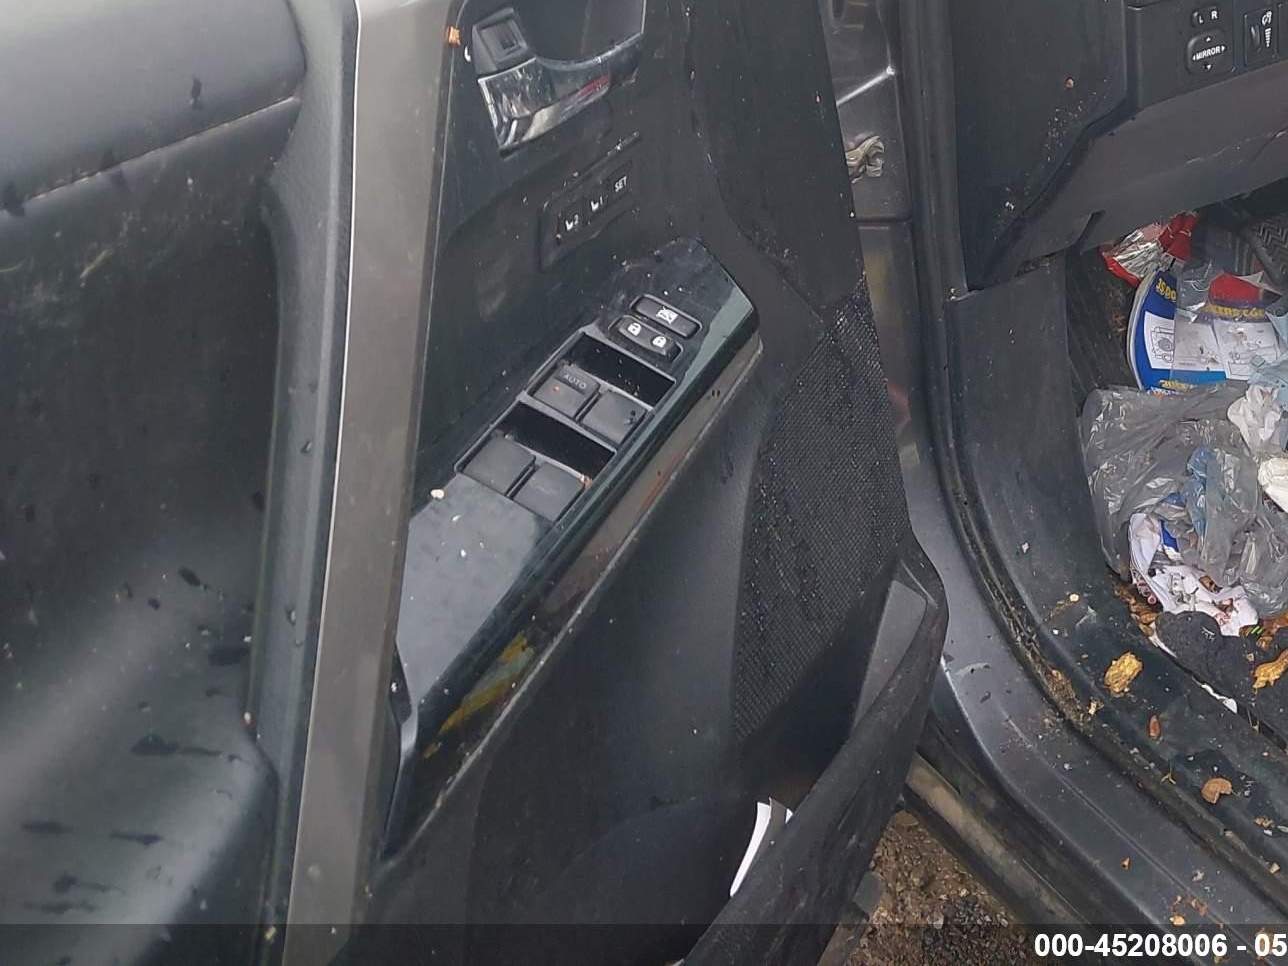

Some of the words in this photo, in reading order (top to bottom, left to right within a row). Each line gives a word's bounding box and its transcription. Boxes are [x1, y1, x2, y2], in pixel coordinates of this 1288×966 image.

[1211, 10, 1218, 20] R
[1195, 45, 1221, 61] MIRROR
[614, 175, 628, 193] SET
[563, 373, 587, 390] AUTO
